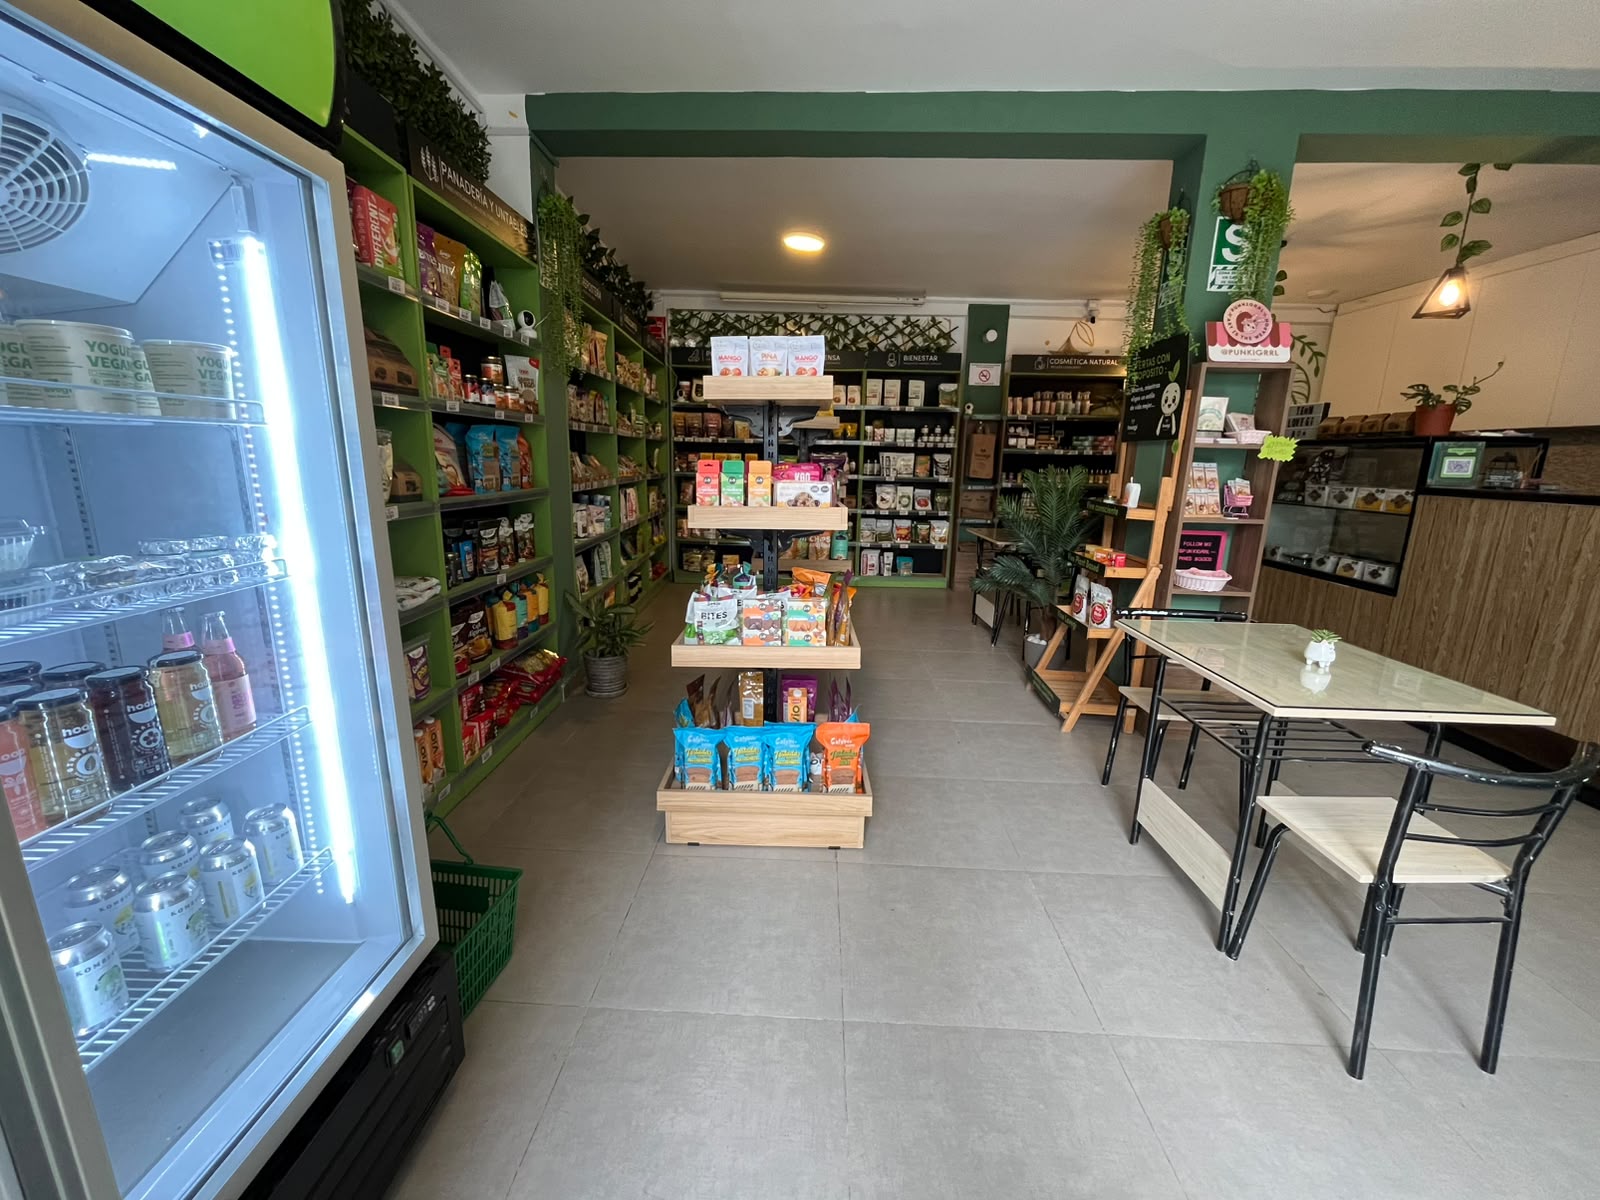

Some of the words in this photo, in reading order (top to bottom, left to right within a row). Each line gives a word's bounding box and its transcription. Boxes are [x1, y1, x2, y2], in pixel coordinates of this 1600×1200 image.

[441, 161, 488, 208] PANADERÍA
[1049, 357, 1088, 365] COSMÉTICA
[1156, 352, 1171, 365] CON
[701, 611, 728, 621] BITES
